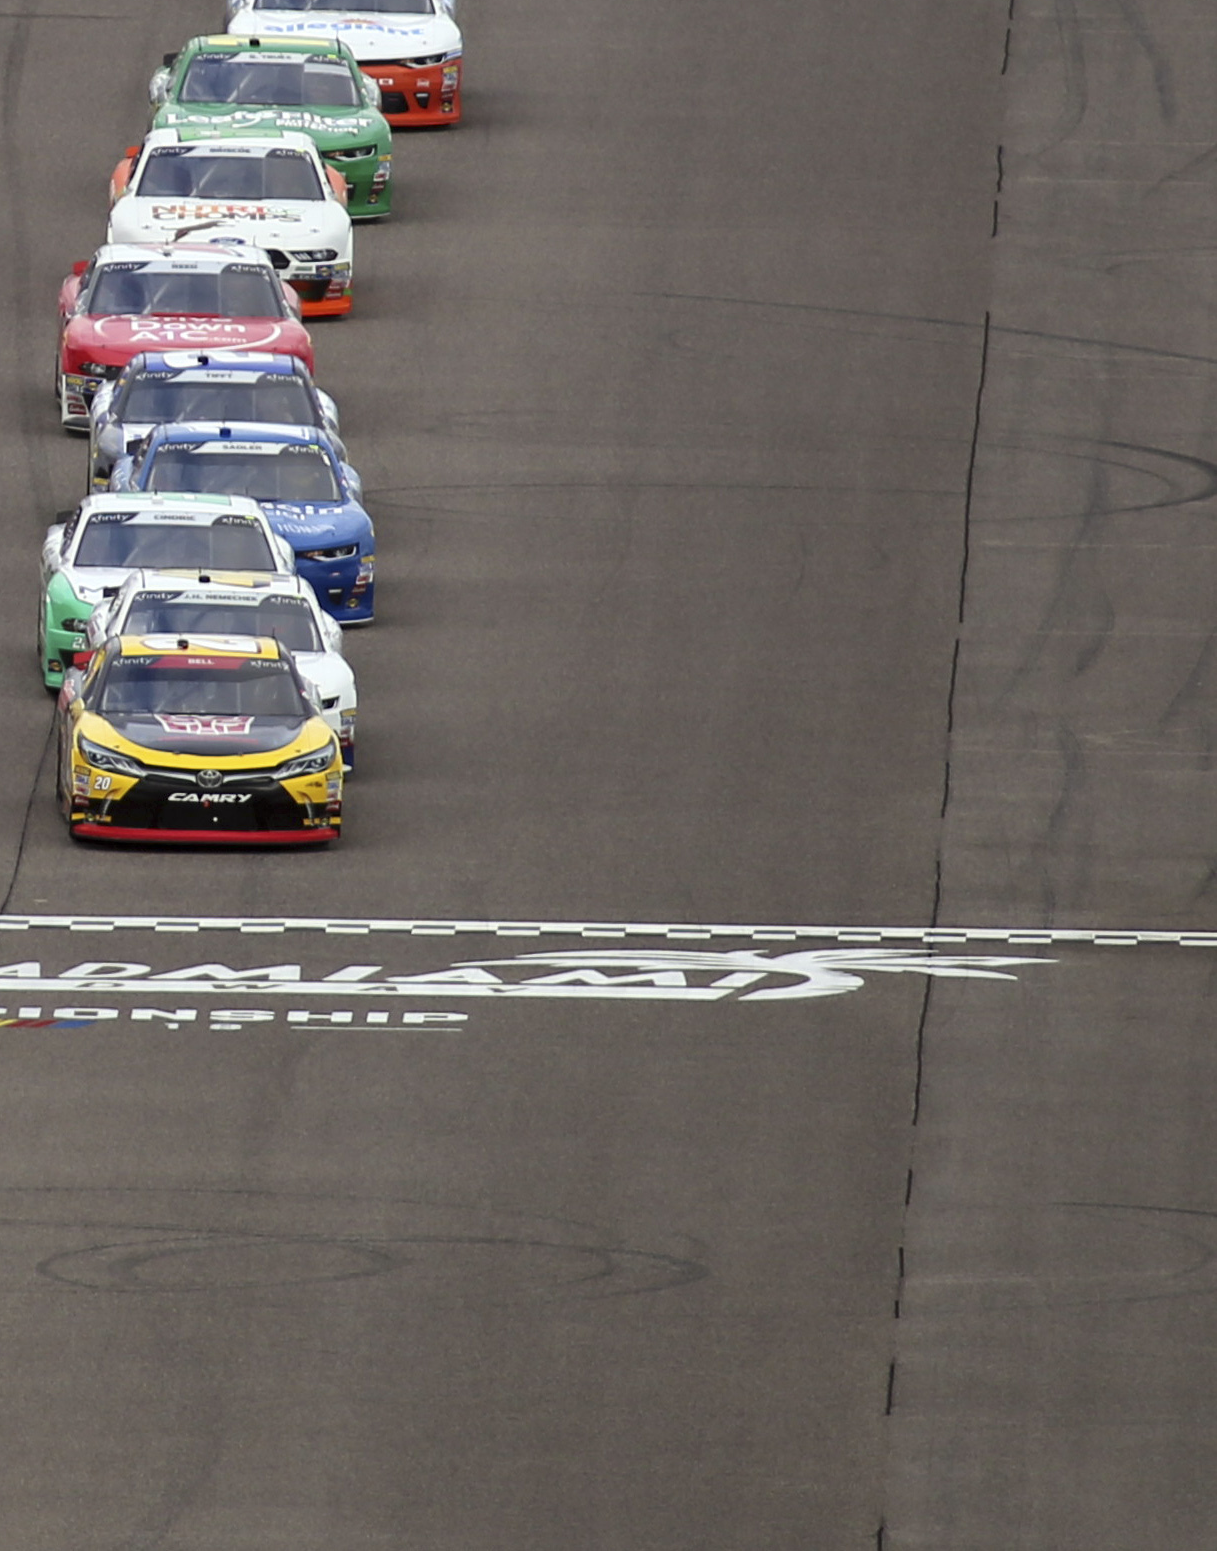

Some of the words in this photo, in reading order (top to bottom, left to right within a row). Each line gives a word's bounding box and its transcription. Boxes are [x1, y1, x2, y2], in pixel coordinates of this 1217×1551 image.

[130, 320, 246, 333] Down
[94, 775, 111, 790] 20
[167, 792, 252, 803] CAMRY
